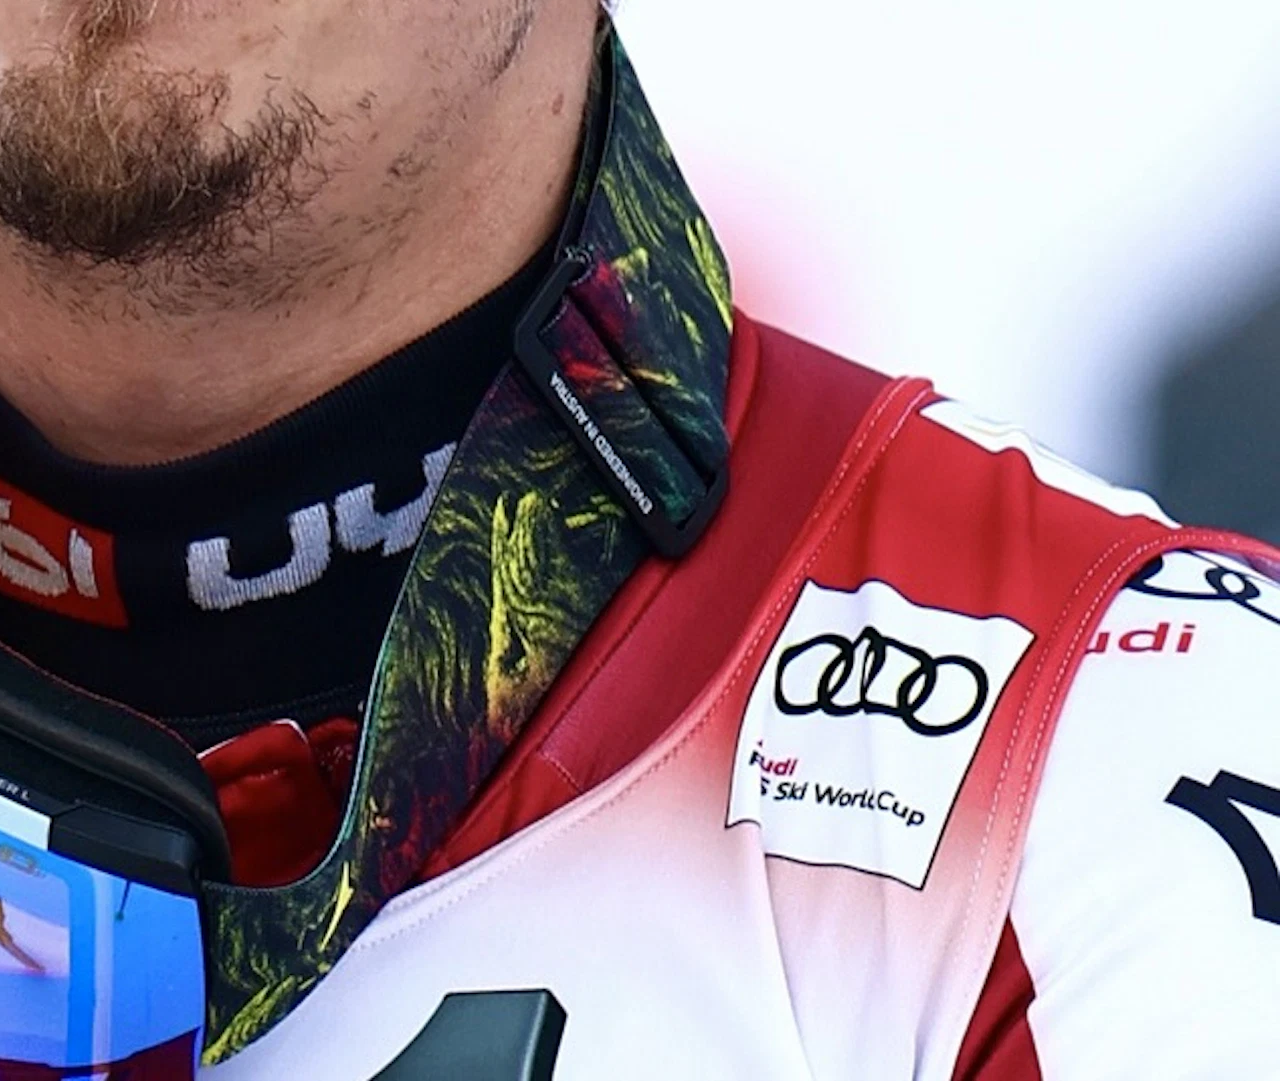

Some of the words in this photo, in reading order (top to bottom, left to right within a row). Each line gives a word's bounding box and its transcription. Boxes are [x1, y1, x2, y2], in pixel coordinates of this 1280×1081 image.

[550, 371, 589, 425] AUSTRIA
[1086, 622, 1197, 655] udi
[772, 780, 809, 802] Ski
